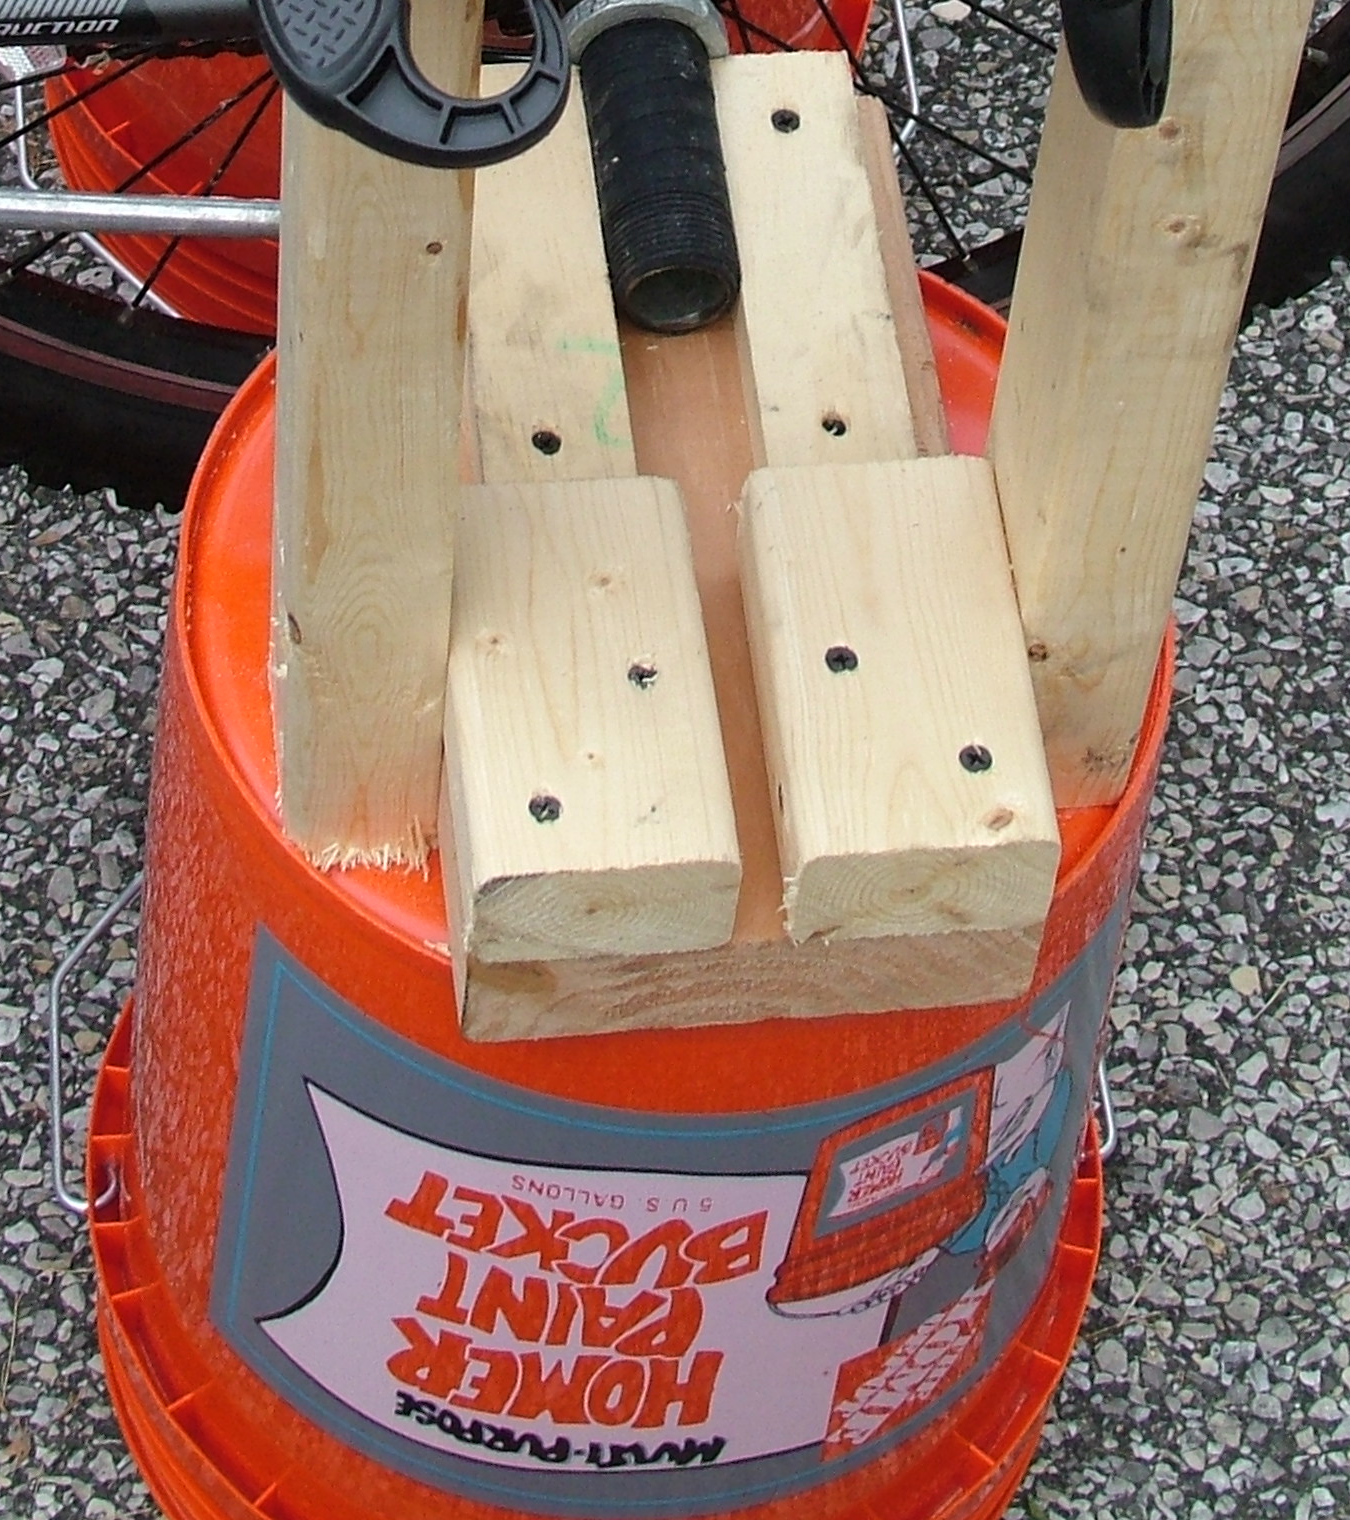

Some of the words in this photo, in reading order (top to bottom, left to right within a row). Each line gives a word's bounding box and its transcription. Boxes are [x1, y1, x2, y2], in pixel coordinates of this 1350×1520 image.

[384, 1170, 769, 1289] BUCKET
[510, 1175, 624, 1209] GALLONS
[701, 1197, 713, 1213] 5
[415, 1252, 704, 1359] PAINT
[386, 1318, 724, 1429] HOMER
[393, 1391, 727, 1469] MULTI-PURPOSE
